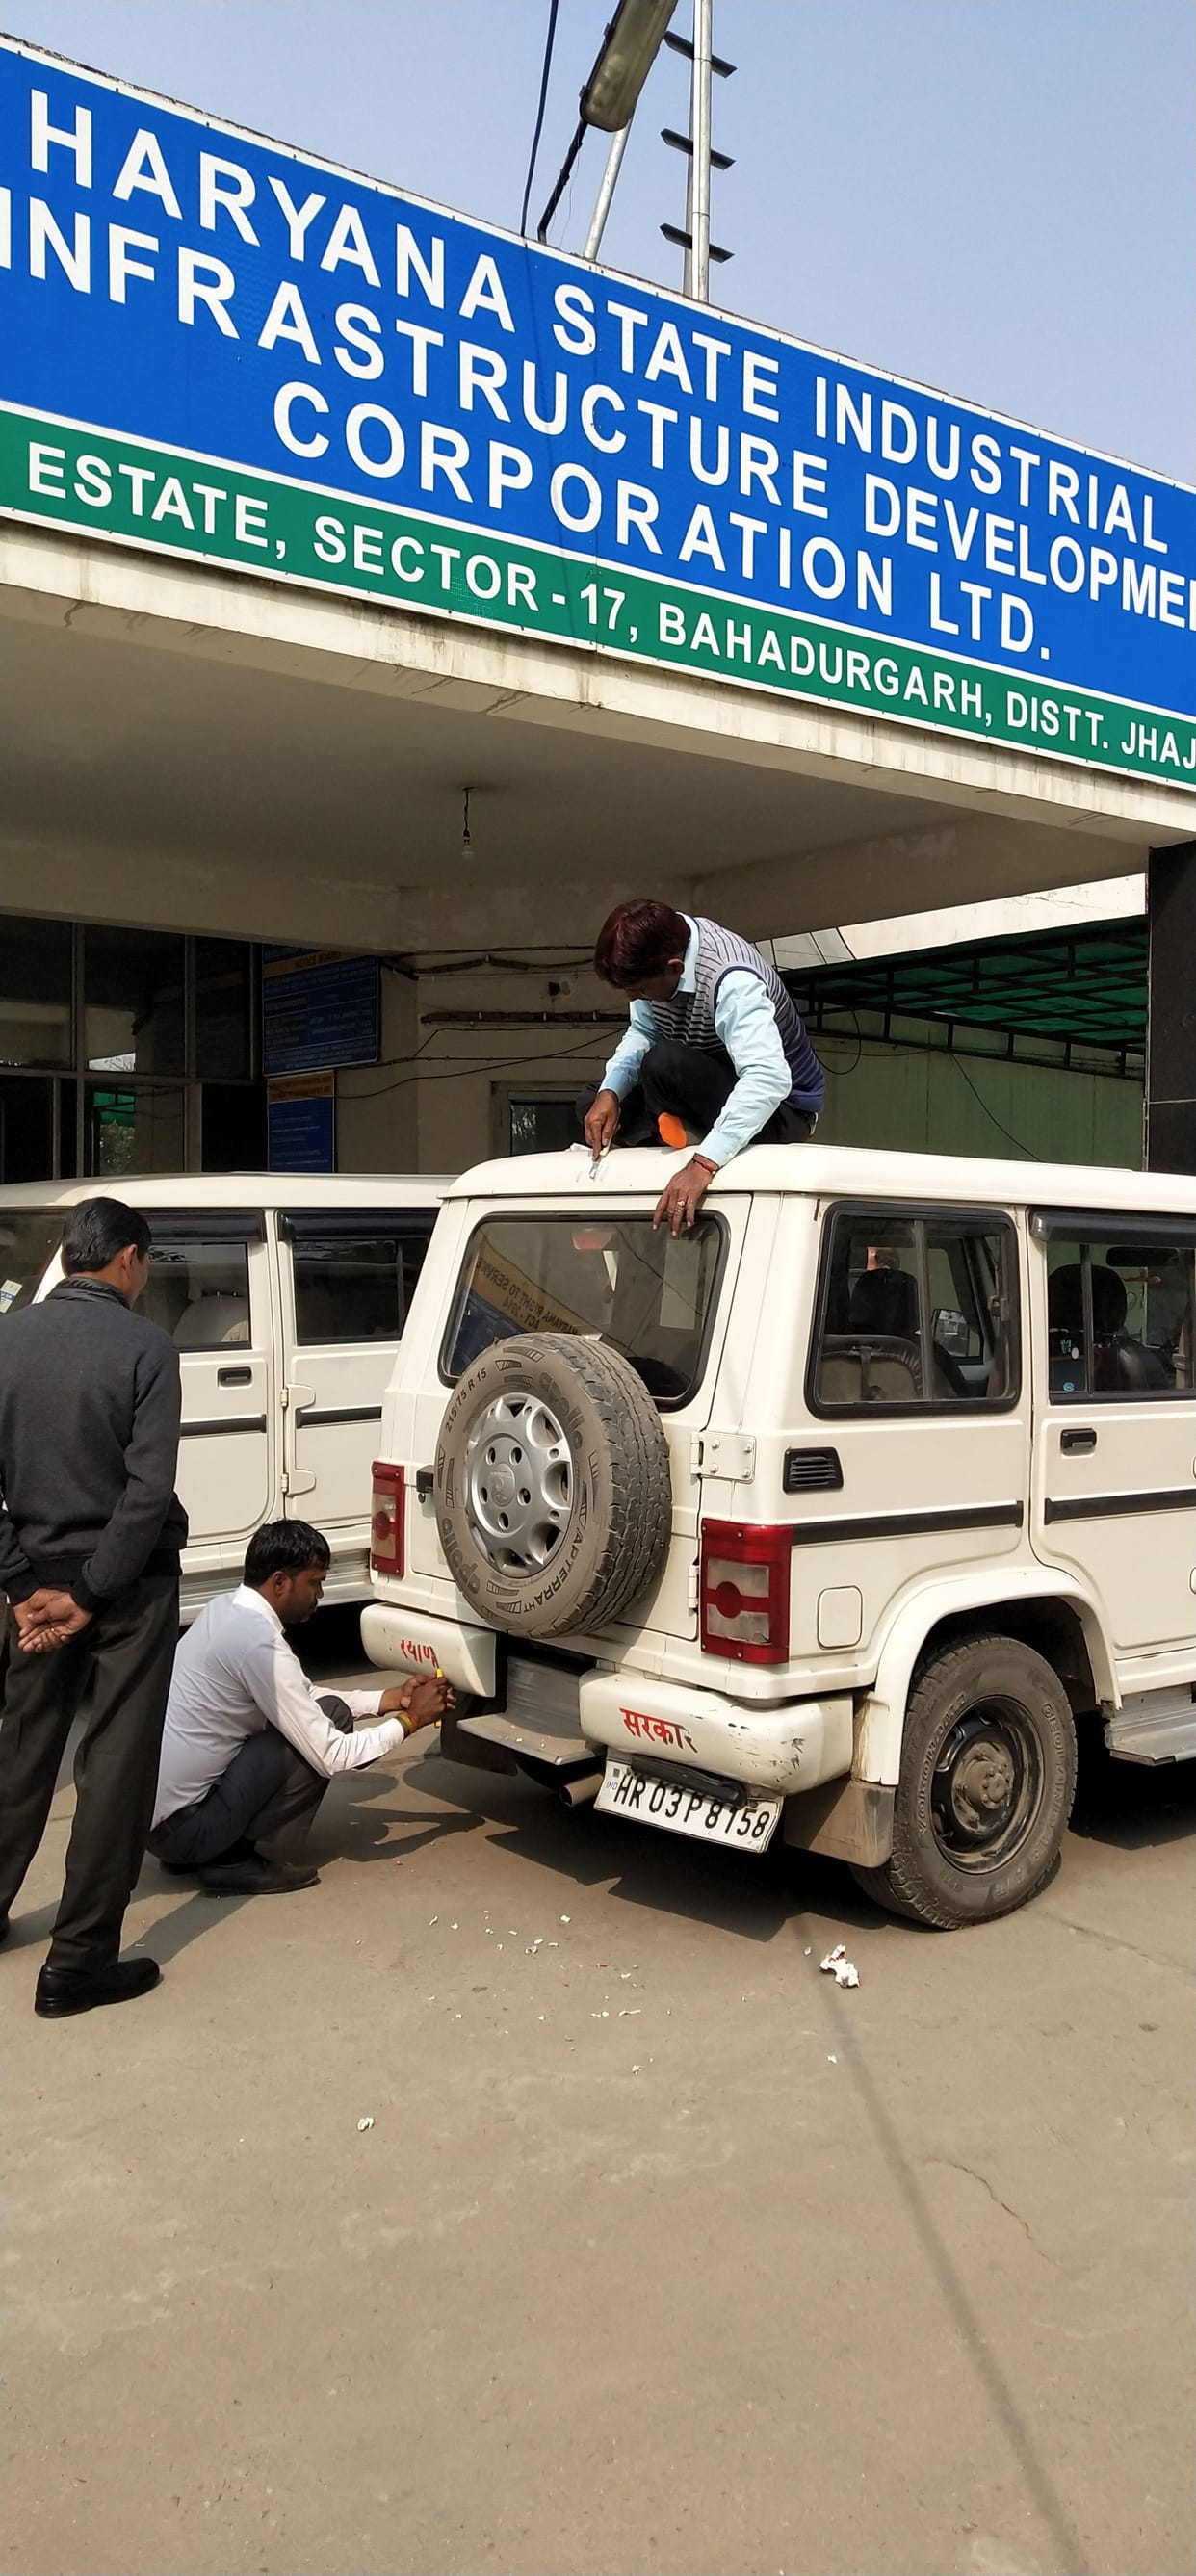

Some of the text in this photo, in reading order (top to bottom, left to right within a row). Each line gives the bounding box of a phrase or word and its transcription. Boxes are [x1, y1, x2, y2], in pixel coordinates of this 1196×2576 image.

[0, 187, 1196, 632] INFRASTRUCTURE DEVELOPME
[32, 90, 1167, 553] HARYANA STATE INDUSTRIAL
[29, 442, 286, 559] ESTATE,
[314, 516, 539, 611] SECTOR
[580, 584, 637, 643] 17,
[659, 603, 992, 727] BAHADURGARH,
[1007, 691, 1109, 750] DISTT.
[1121, 722, 1196, 770] JHAJ
[274, 382, 1050, 660] CORPORATION LTD.
[467, 1379, 476, 1392] R
[478, 1367, 487, 1382] 15
[619, 1707, 698, 1754] सरकार
